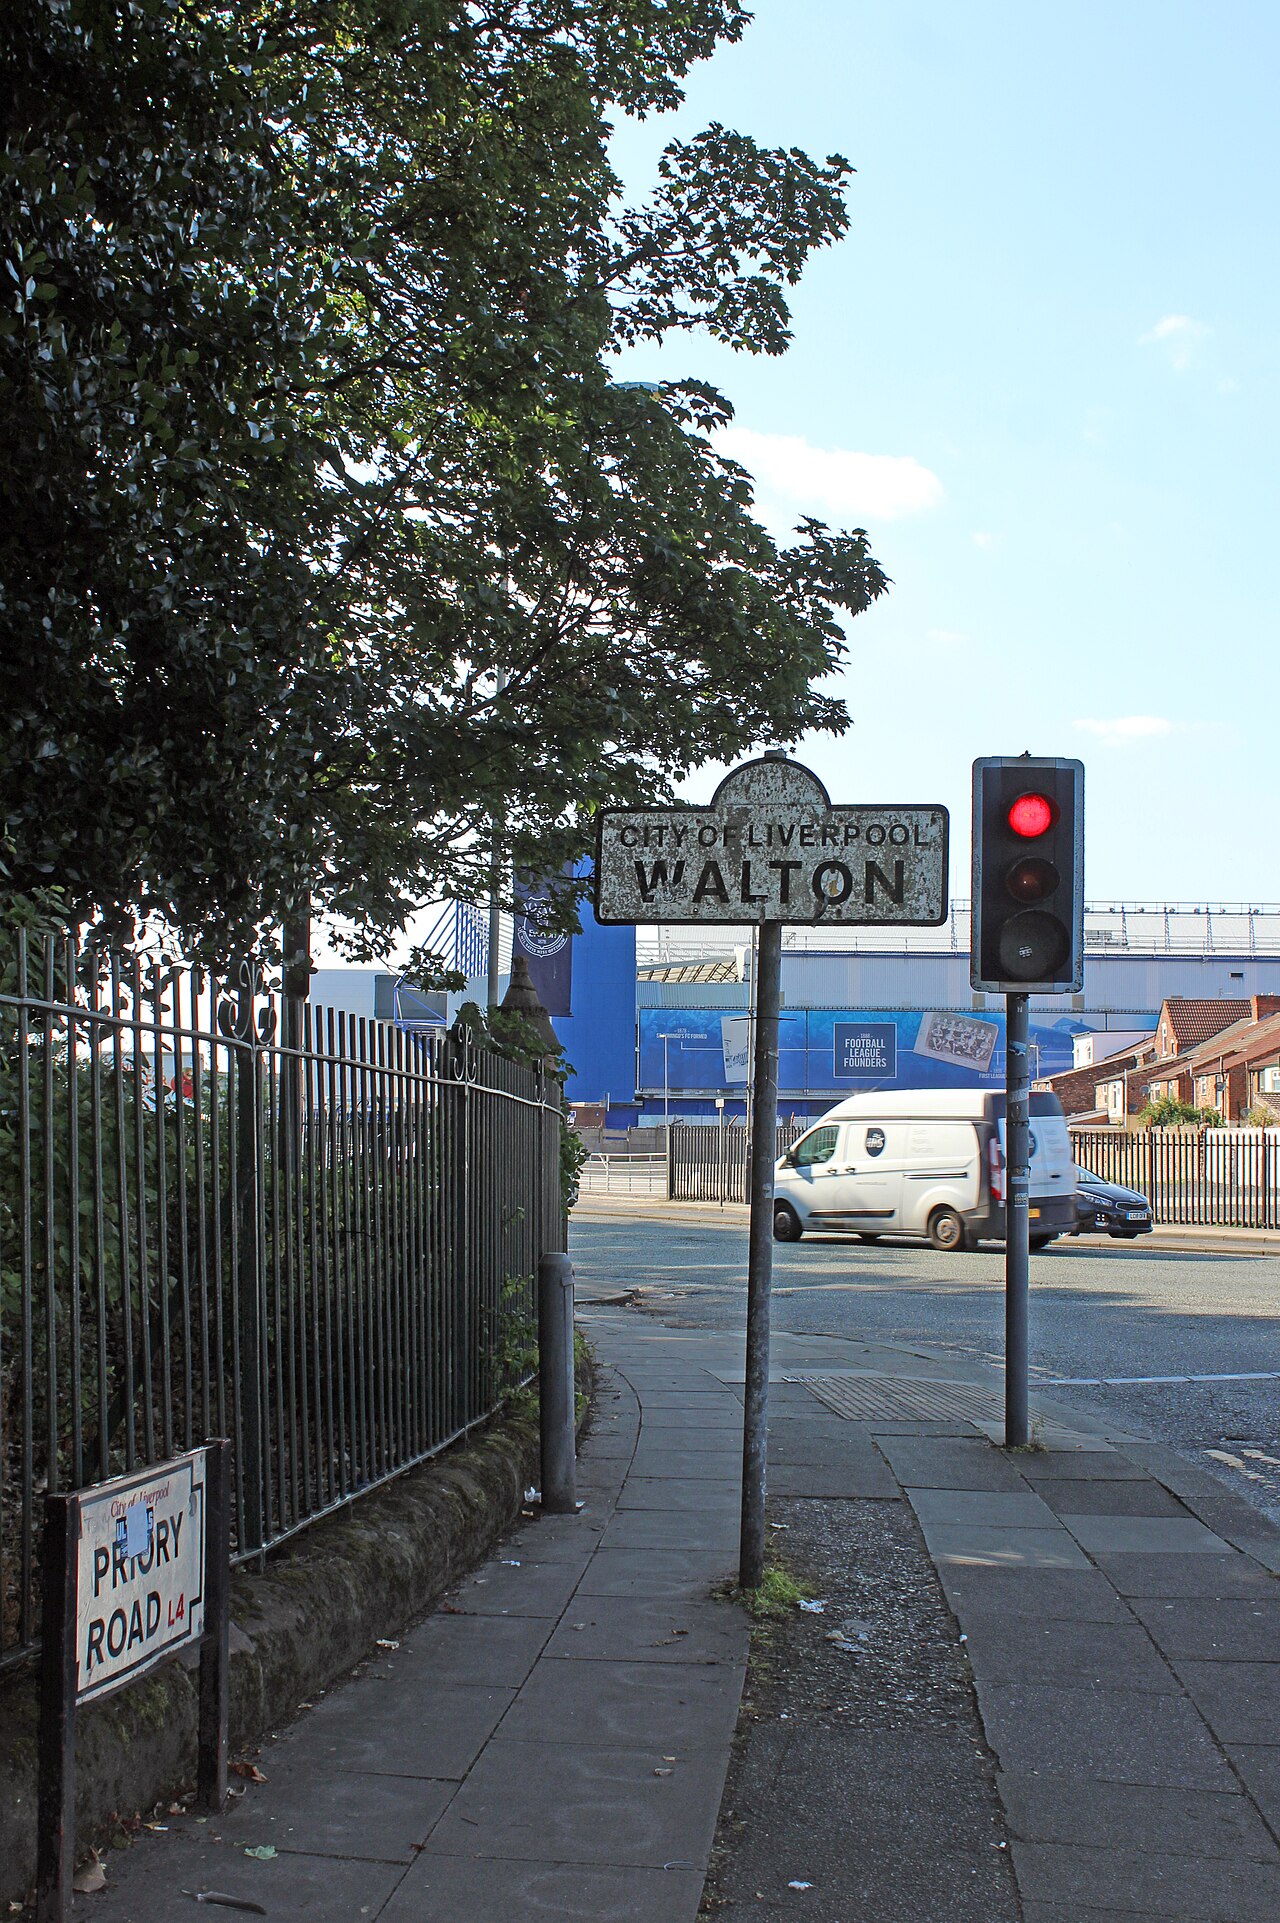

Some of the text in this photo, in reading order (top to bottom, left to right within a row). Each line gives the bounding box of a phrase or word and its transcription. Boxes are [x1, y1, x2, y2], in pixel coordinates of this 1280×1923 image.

[620, 823, 930, 848] CITY OF LIVERPOOL
[634, 860, 905, 905] WALTON
[844, 1038, 886, 1049] FOOTBALL
[849, 1048, 881, 1058] LEAGUE
[843, 1057, 887, 1068] FOUNDERS
[110, 1498, 127, 1519] City
[86, 1590, 185, 1671] ROAD L4
